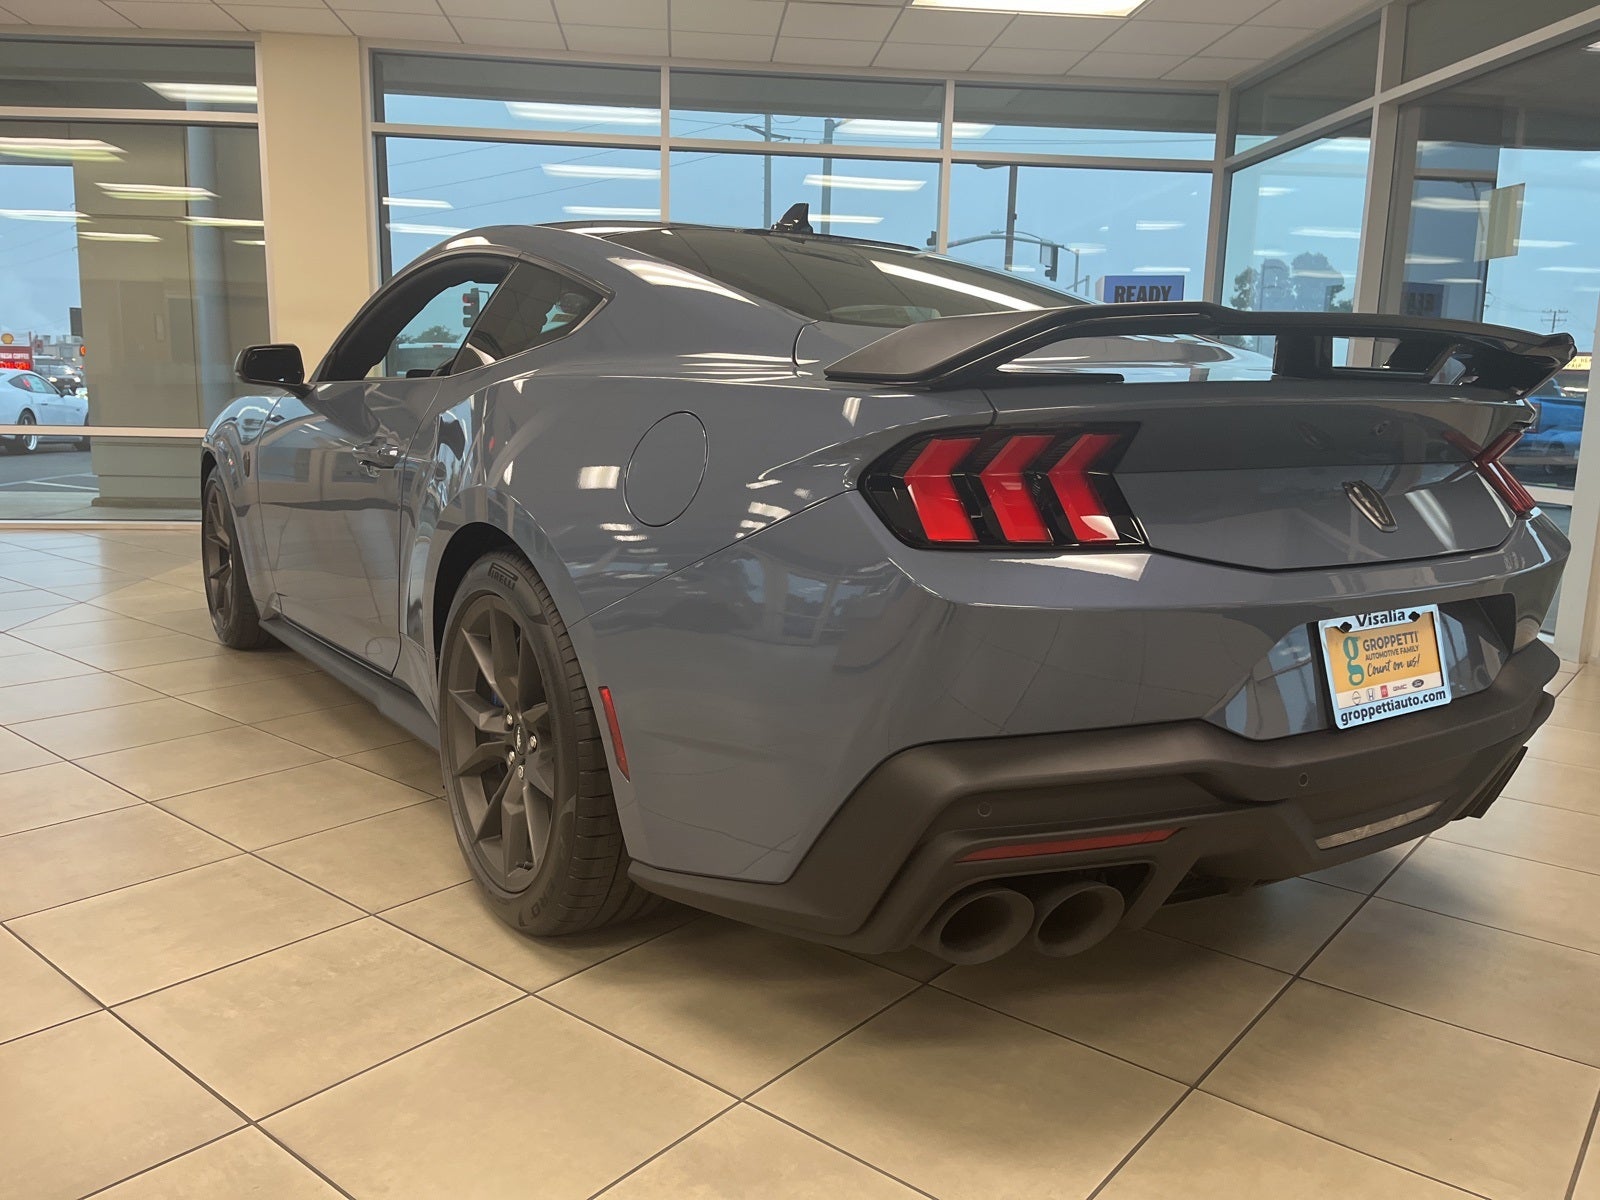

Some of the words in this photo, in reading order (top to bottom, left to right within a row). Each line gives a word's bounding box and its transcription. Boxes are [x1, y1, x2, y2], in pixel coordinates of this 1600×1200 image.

[1114, 285, 1172, 303] READY
[488, 562, 519, 590] PIRELLI
[1356, 610, 1406, 627] Visalia
[1363, 631, 1419, 652] GROPPETTI
[1365, 648, 1400, 661] AUTOMOTIVE
[1400, 645, 1419, 655] FAMILY
[1367, 659, 1391, 677] Count
[1393, 661, 1404, 671] on
[1340, 690, 1447, 726] groppettiauto.com
